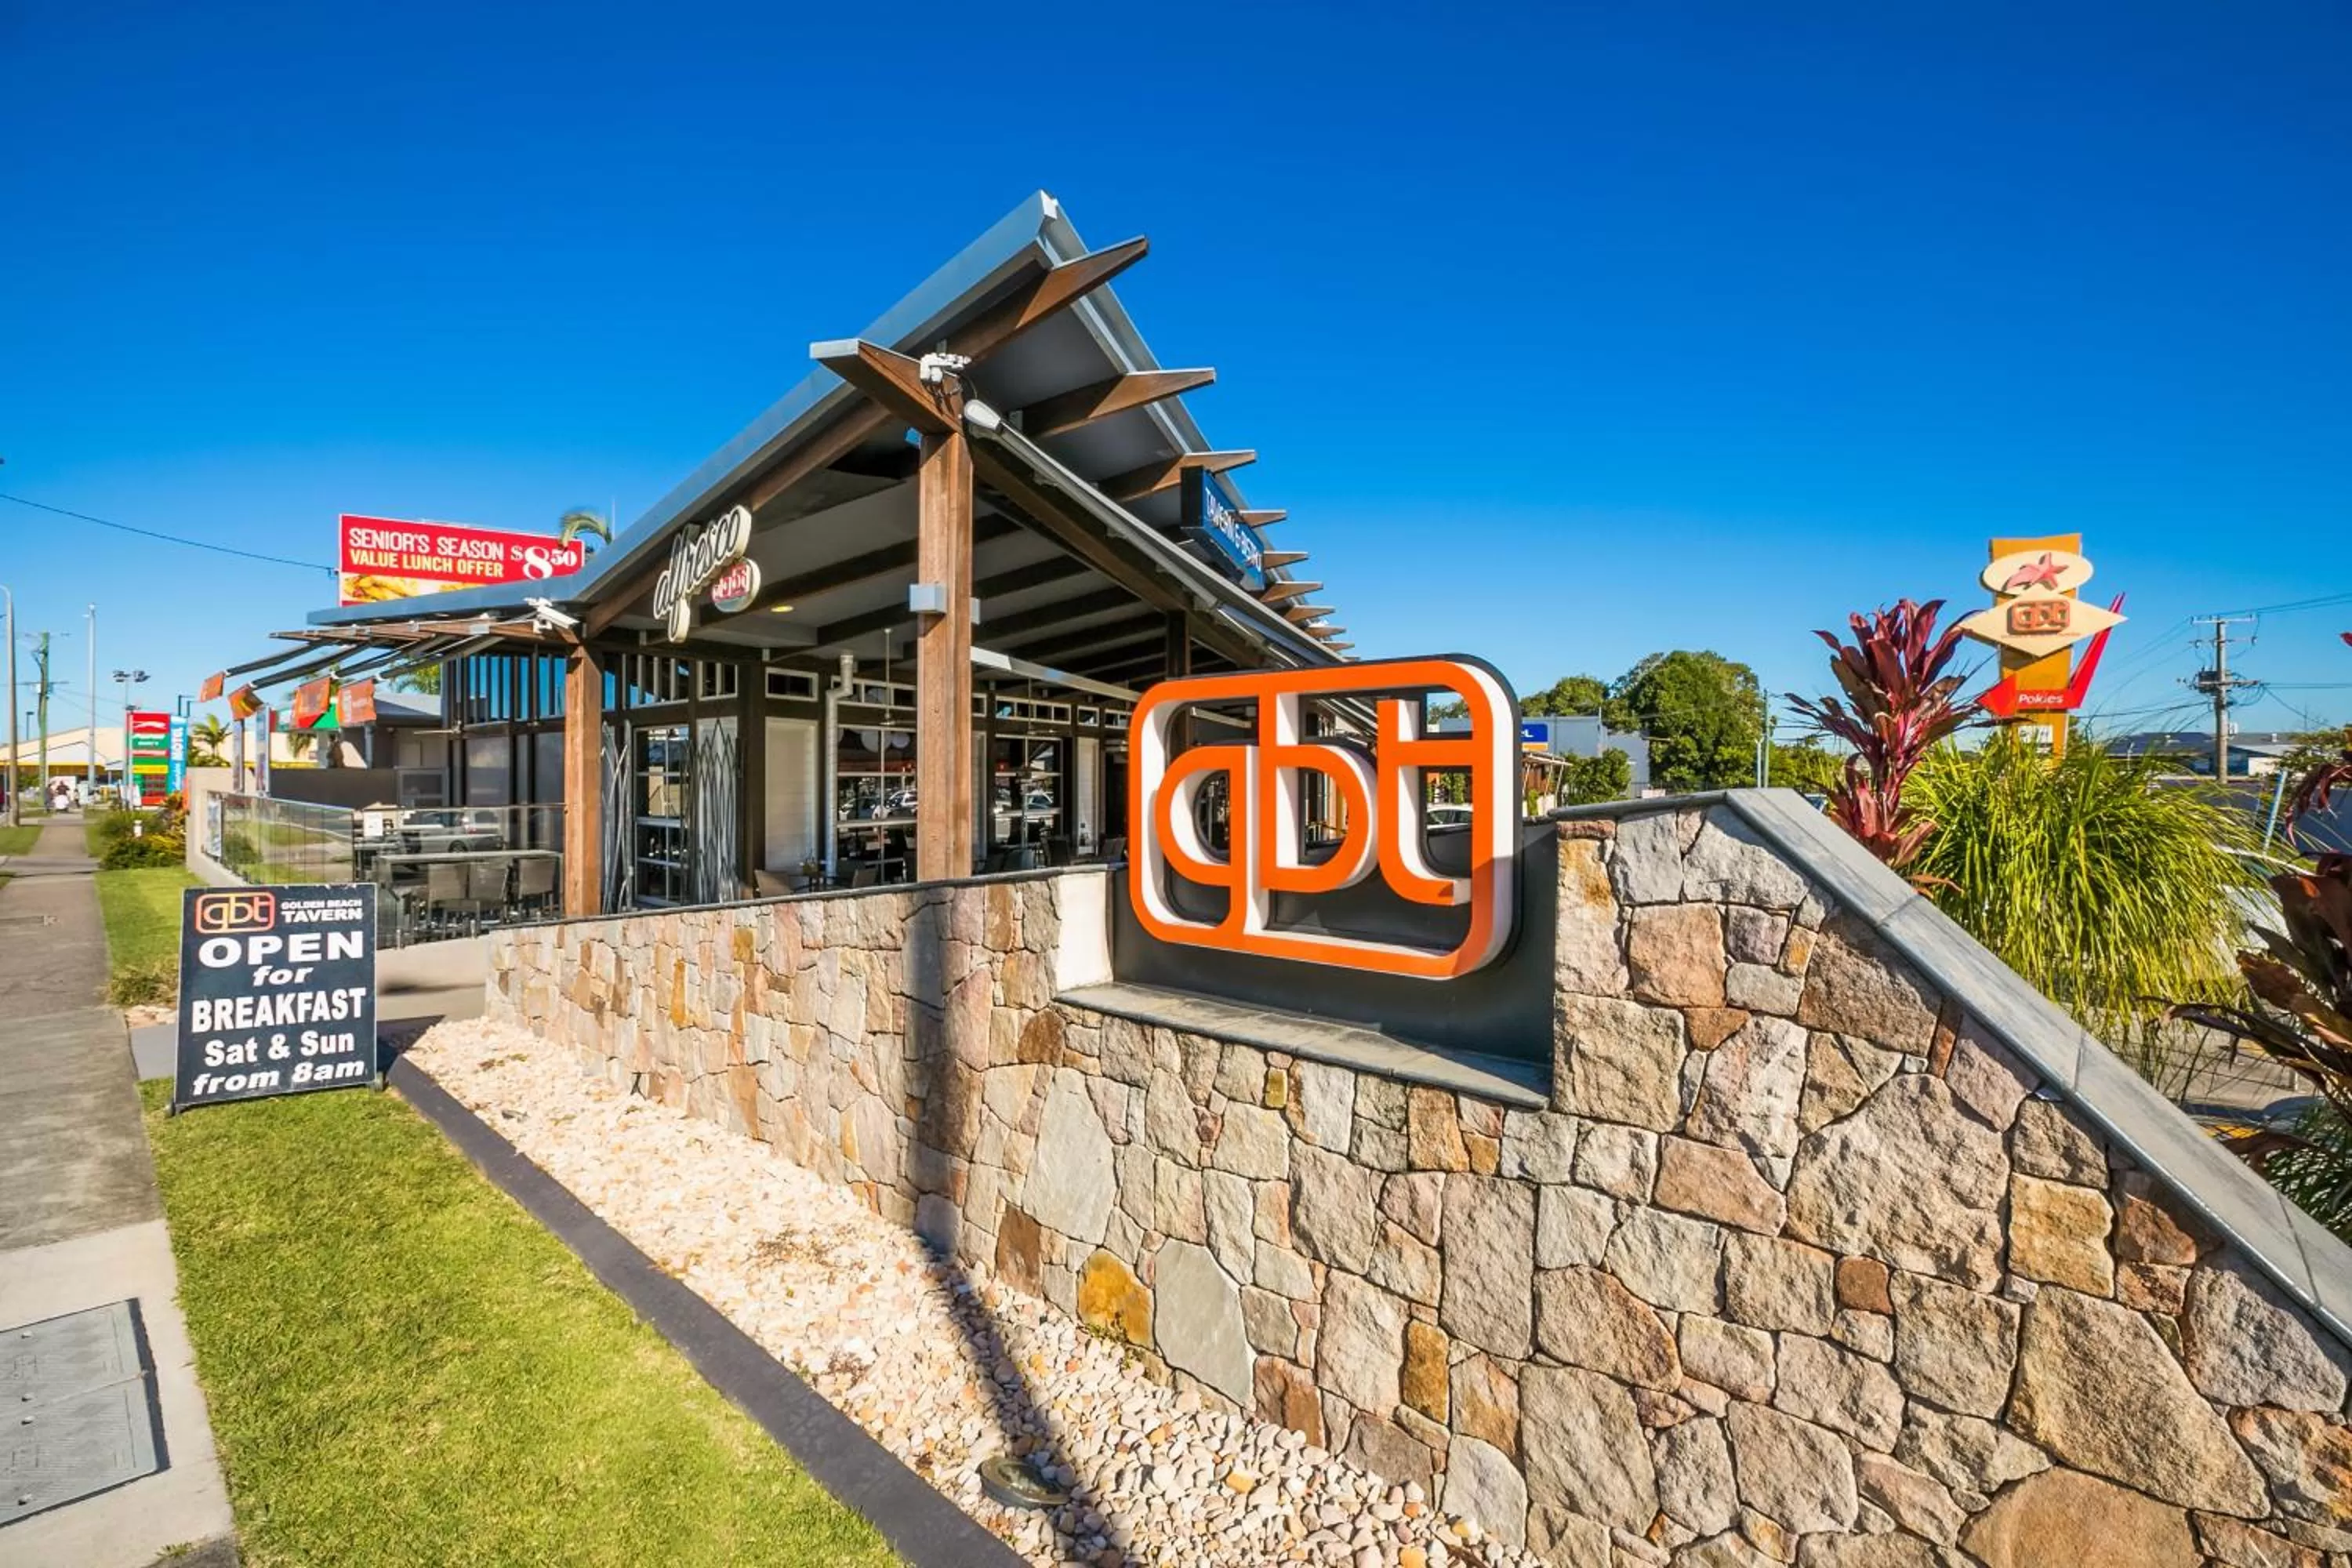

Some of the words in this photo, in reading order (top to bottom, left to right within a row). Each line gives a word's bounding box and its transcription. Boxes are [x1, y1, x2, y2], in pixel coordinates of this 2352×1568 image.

[349, 528, 430, 554] SENIOR'S
[437, 535, 504, 561] SEASON
[350, 549, 397, 568] VALUE
[402, 554, 452, 573] LUNCH
[456, 560, 504, 578] OFFER
[2018, 693, 2064, 704] Pokies
[1149, 663, 1482, 956] gbt
[199, 894, 271, 932] gbt
[281, 908, 364, 923] TAVERN
[198, 931, 364, 968] OPEN
[252, 965, 314, 986] for
[191, 988, 367, 1033] BREAKFAST
[204, 1036, 258, 1067] Sat
[267, 1033, 291, 1060] &
[300, 1030, 355, 1057] Sun
[192, 1070, 280, 1095] from
[292, 1061, 366, 1083] 8am
